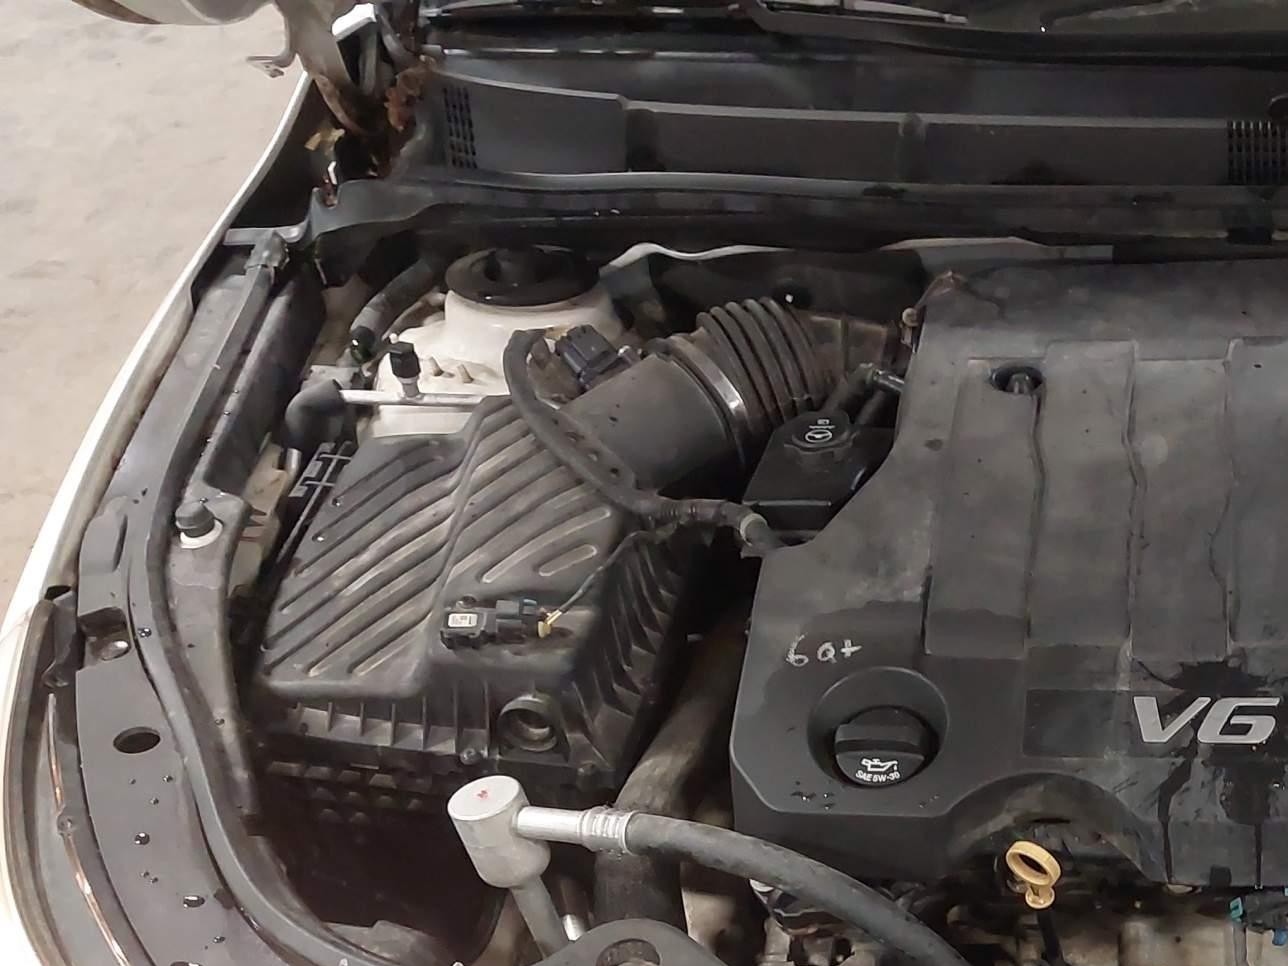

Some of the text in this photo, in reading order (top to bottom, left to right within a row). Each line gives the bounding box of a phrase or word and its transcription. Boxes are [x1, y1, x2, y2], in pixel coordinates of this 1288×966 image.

[786, 634, 809, 667] 6
[1133, 696, 1281, 744] V6
[856, 770, 900, 783] SAE 5W-30
